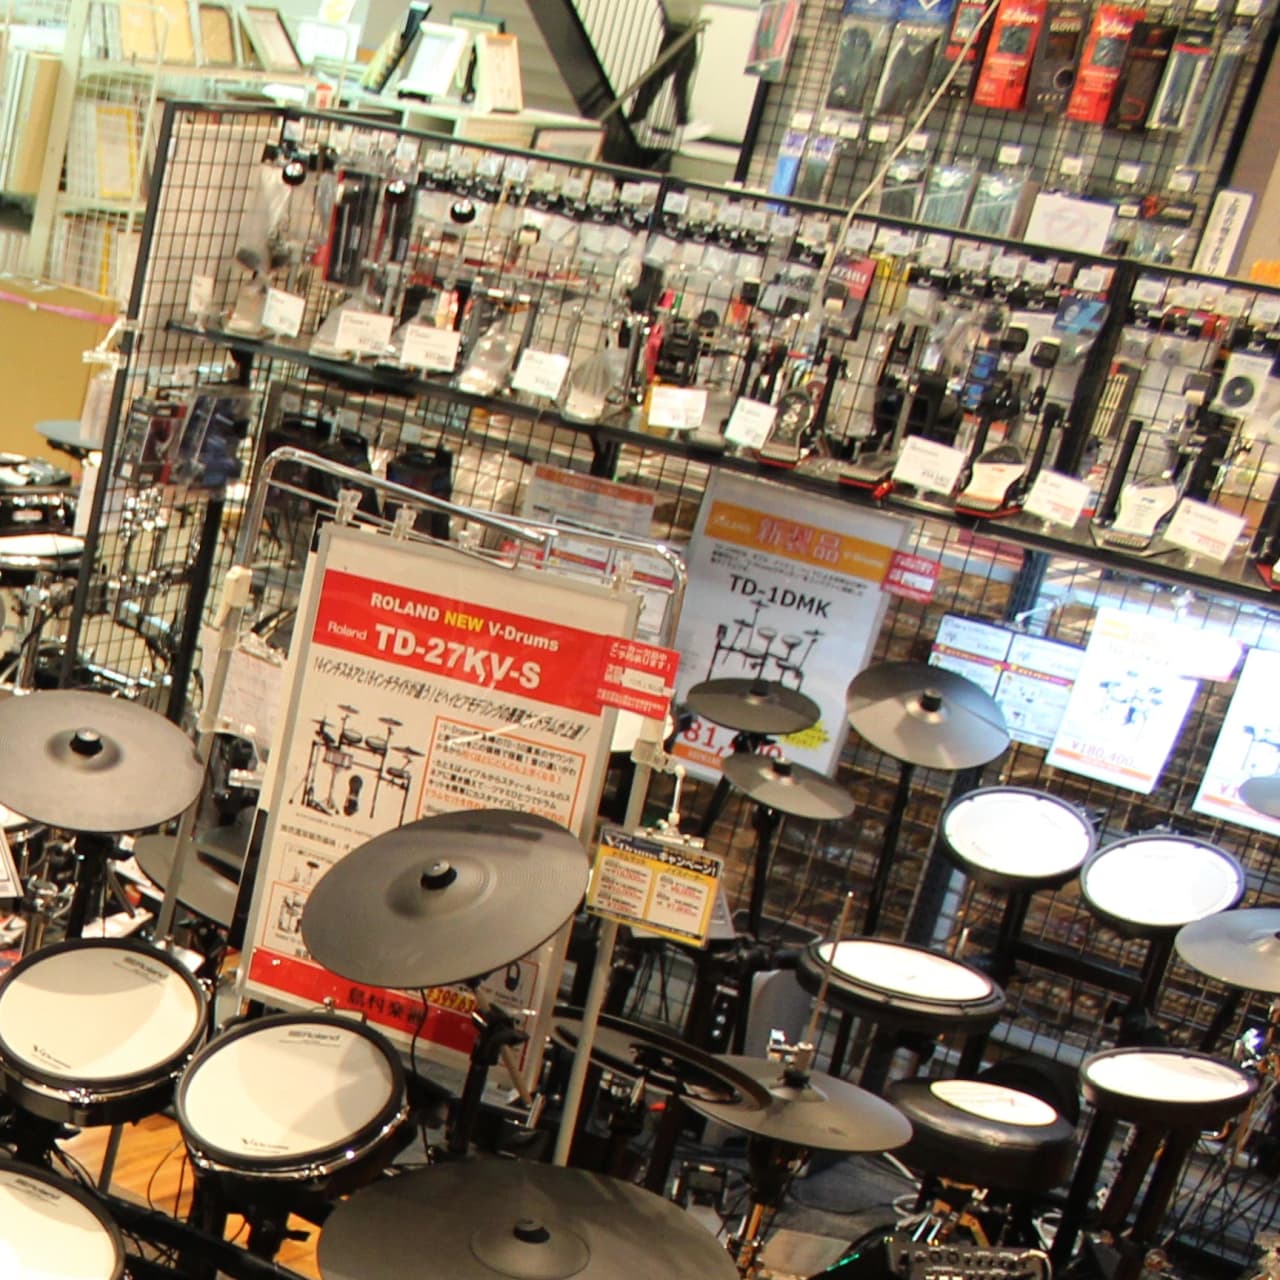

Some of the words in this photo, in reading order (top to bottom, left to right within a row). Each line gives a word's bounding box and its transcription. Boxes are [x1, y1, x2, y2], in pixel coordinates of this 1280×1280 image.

[756, 518, 842, 563] 新製品
[371, 592, 439, 622] ROLAND
[444, 610, 484, 632] NEW
[488, 621, 559, 652] V-Drums
[730, 574, 832, 618] TD-1DMK
[327, 621, 368, 641] Roland
[375, 623, 542, 690] TD-27KV-S
